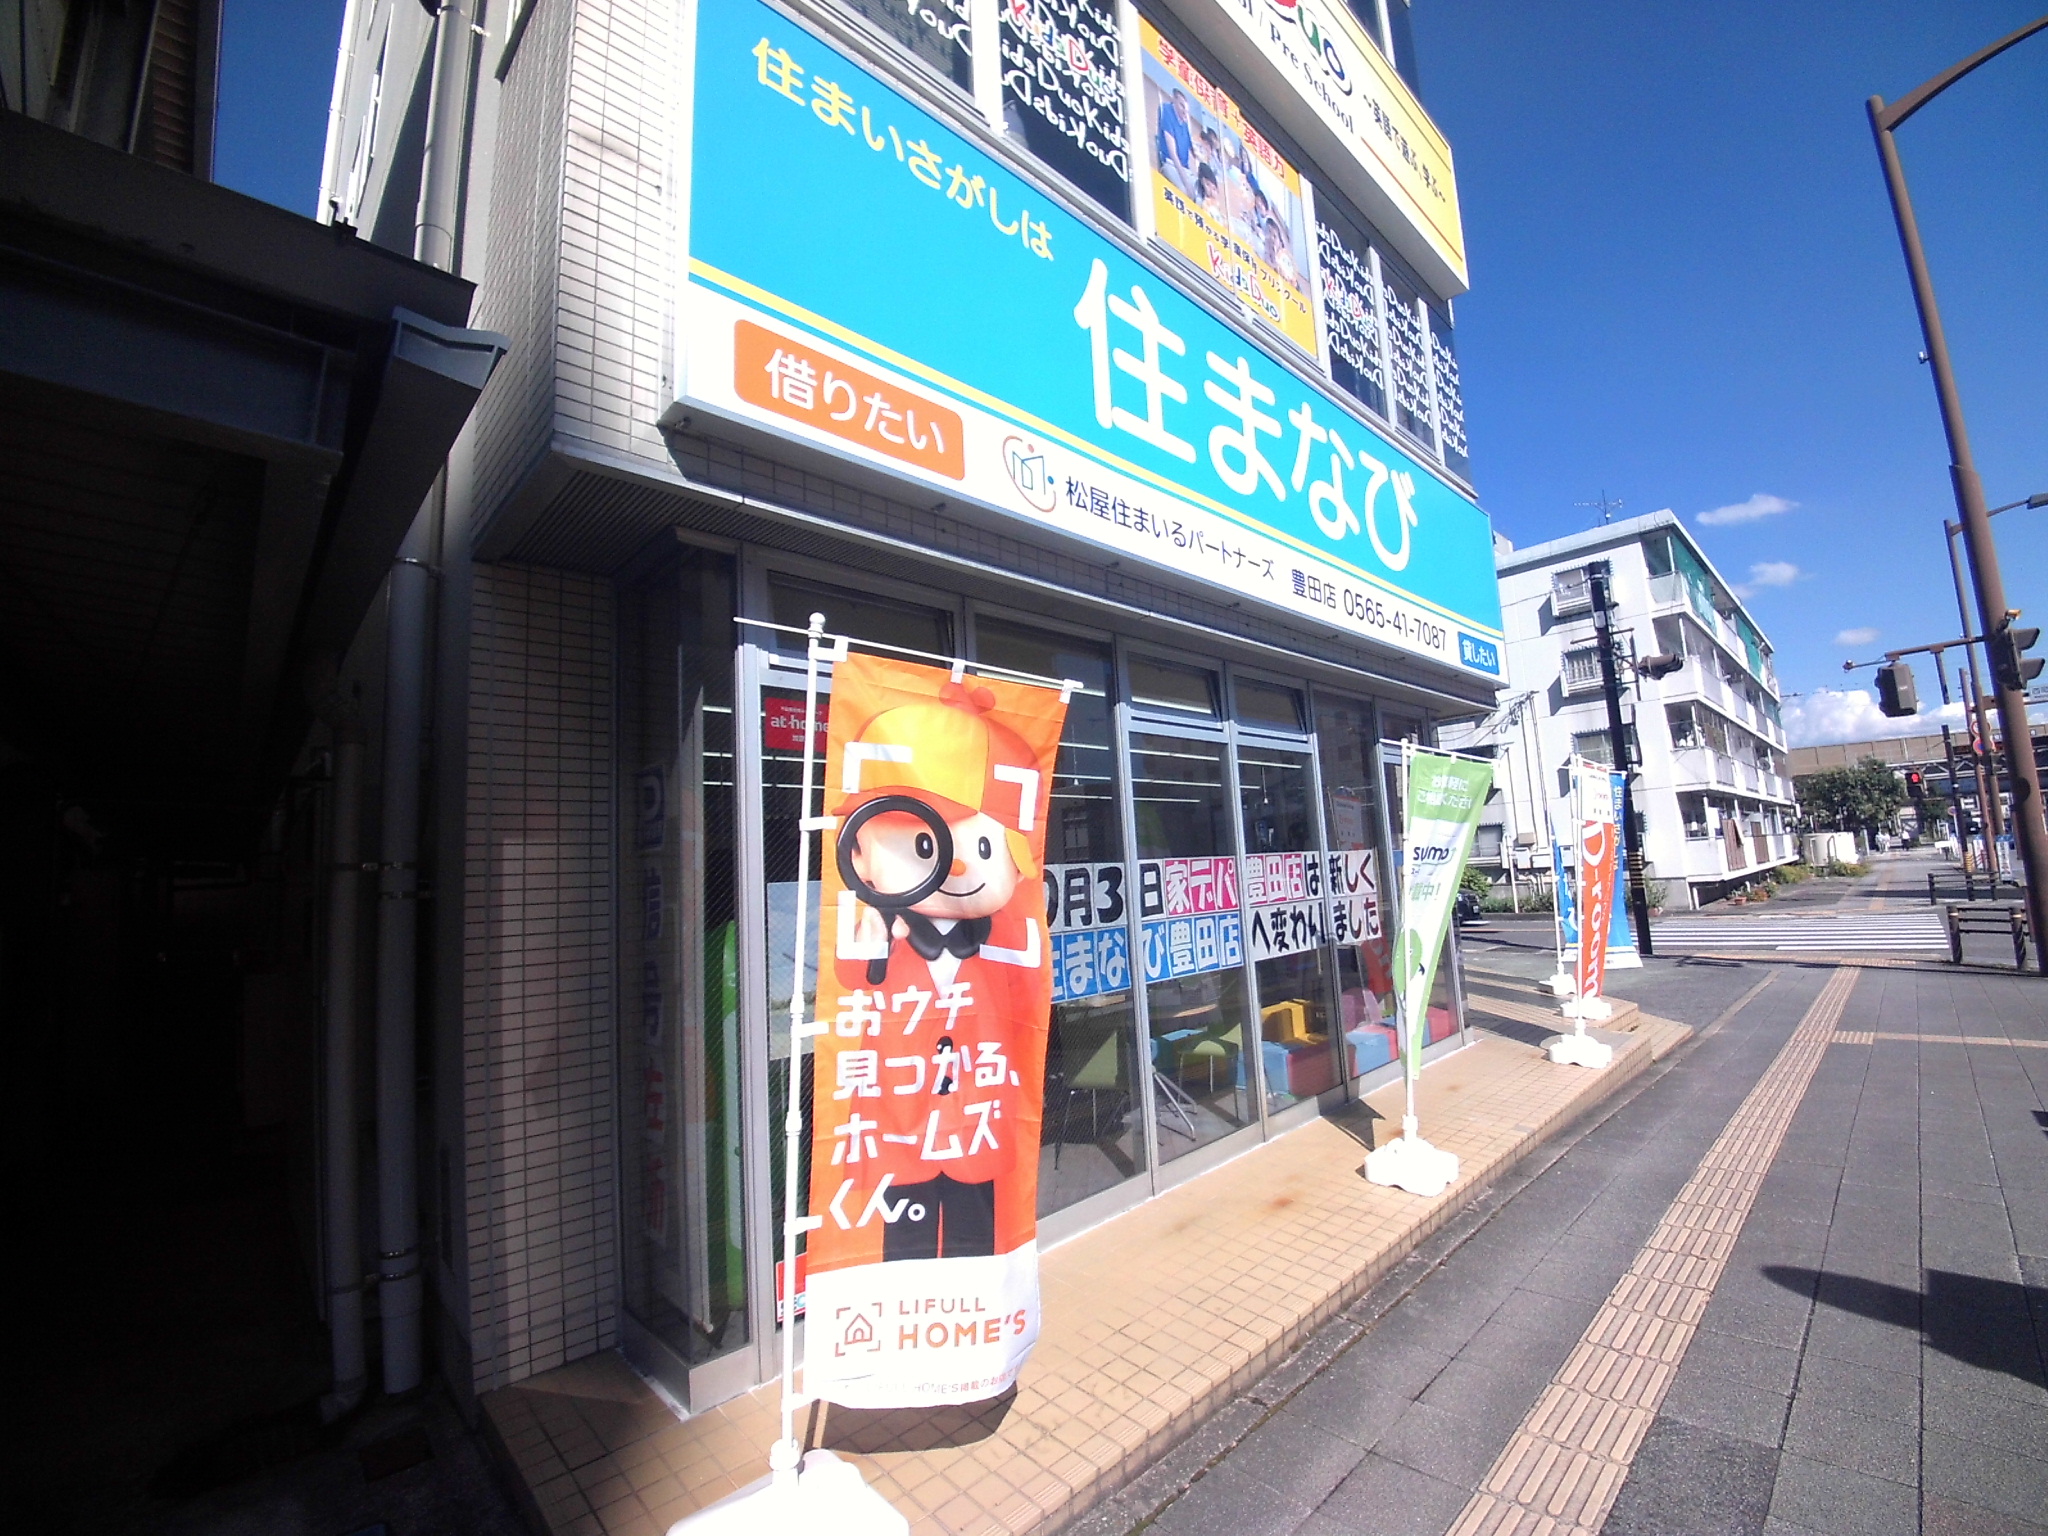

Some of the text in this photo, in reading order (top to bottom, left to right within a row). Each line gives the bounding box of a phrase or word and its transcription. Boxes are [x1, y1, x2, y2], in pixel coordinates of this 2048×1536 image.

[1304, 62, 1354, 134] School
[752, 38, 1054, 261] 住まいさがしは
[765, 348, 945, 454] 借りたい
[1074, 258, 1418, 572] 住まなび
[1066, 476, 1447, 652] 松屋住まいるパートナーズ 豊田店 0565-41-7087
[1462, 638, 1496, 667] 貸したい
[836, 982, 974, 1037] おウチ
[833, 1042, 1020, 1100] 見つかる、
[831, 1100, 1002, 1165] ホームズ
[829, 1173, 926, 1230] くん。
[898, 1309, 1026, 1351] HOME'S
[899, 1297, 986, 1315] LIFULL
